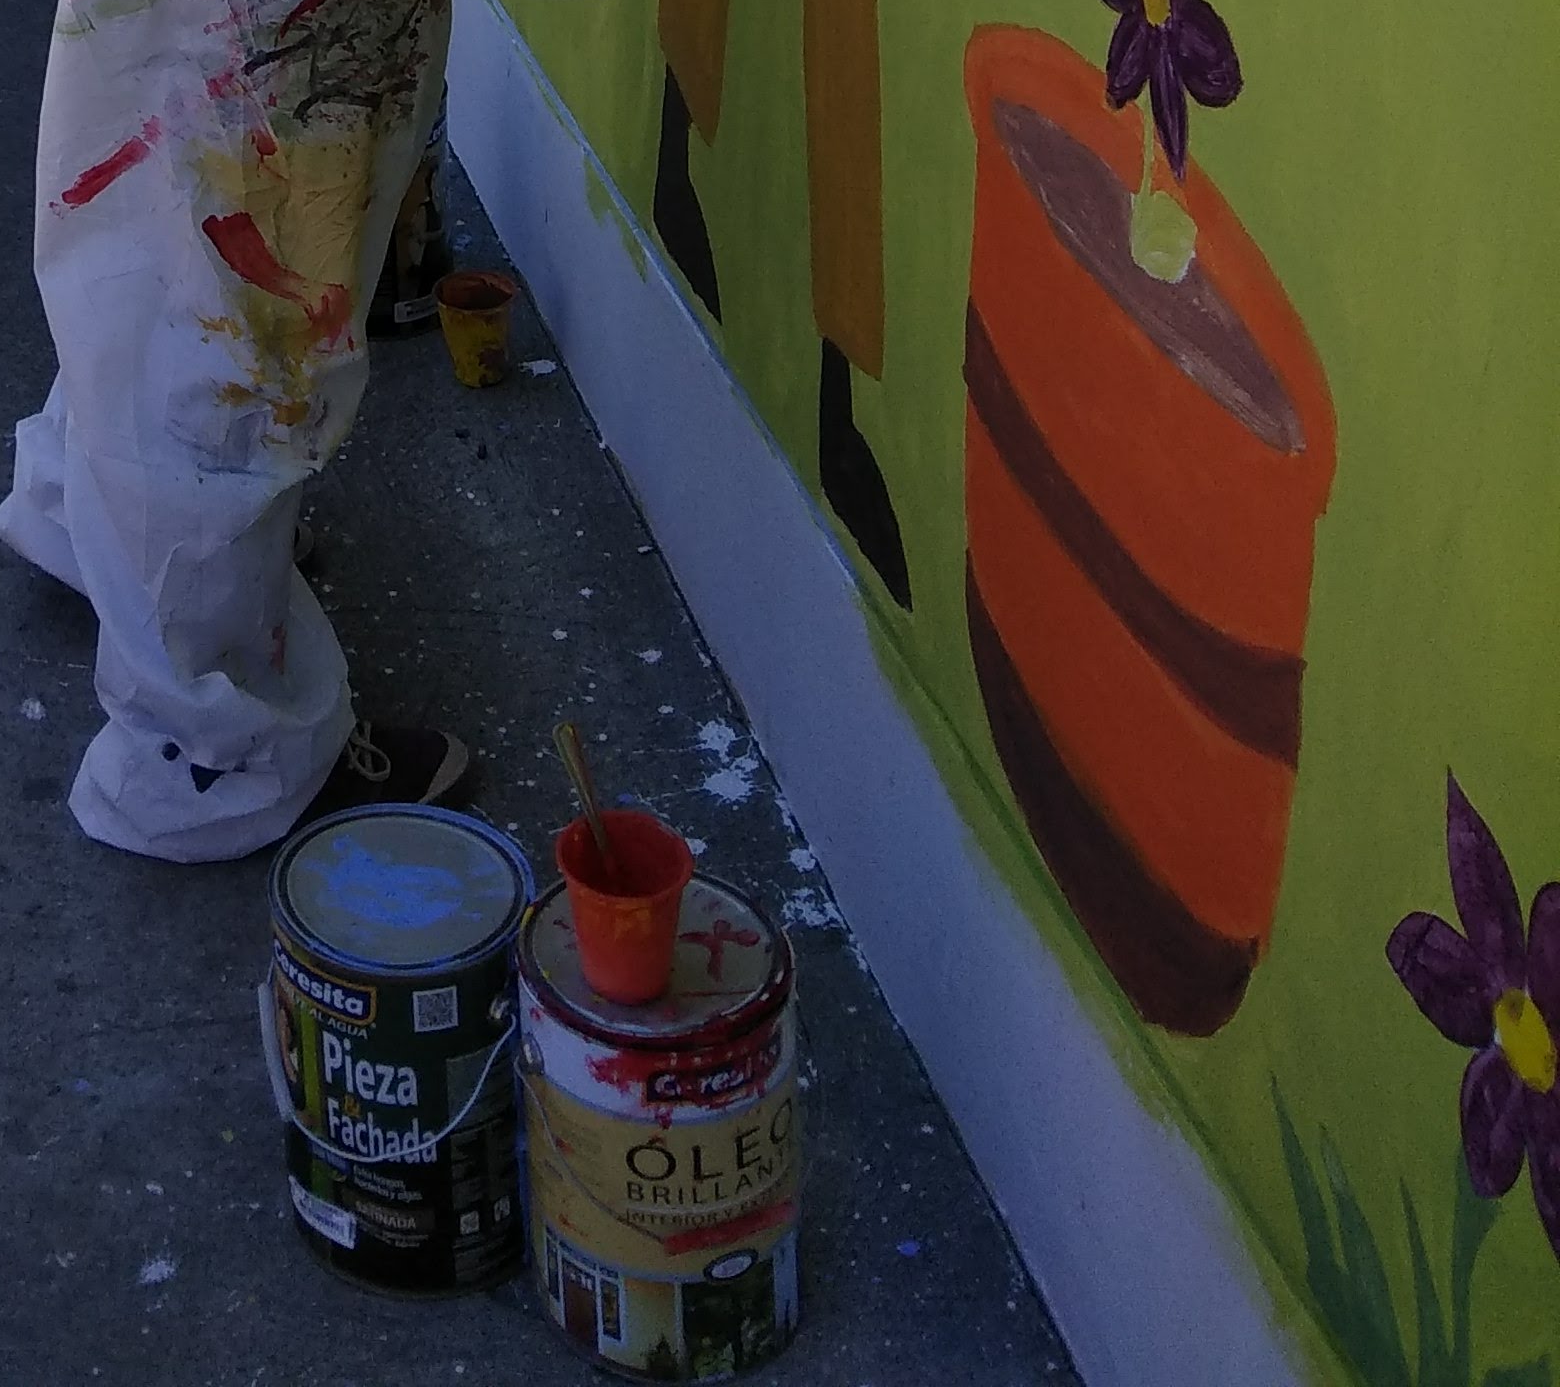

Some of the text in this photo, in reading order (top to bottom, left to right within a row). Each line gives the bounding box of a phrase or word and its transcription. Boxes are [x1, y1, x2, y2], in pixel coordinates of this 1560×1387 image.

[273, 938, 364, 1017] Ceresita
[327, 1017, 368, 1040] AGUA
[322, 1030, 419, 1107] Pieza
[327, 1097, 438, 1165] Fachada
